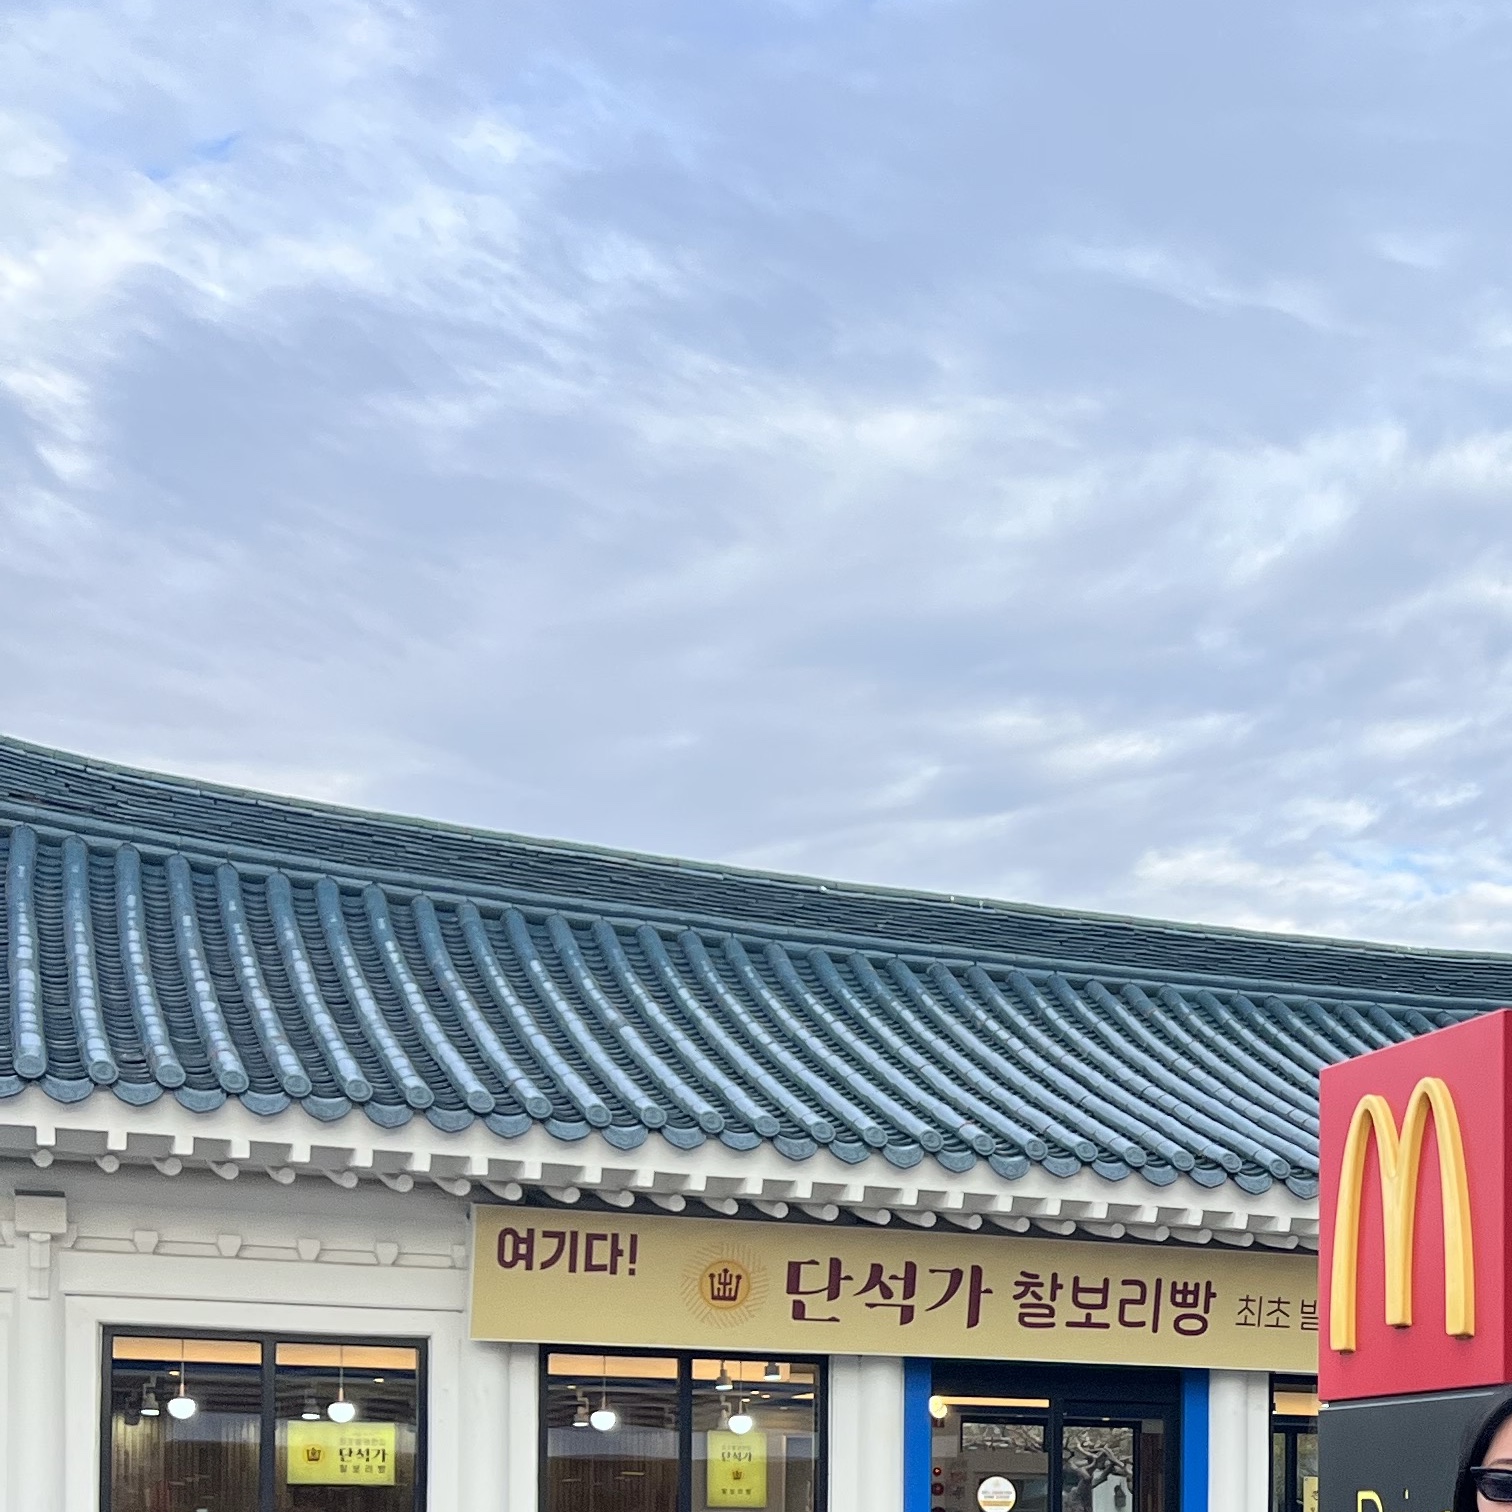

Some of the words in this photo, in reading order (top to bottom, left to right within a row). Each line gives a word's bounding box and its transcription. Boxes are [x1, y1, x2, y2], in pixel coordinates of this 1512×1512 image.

[497, 1227, 638, 1276] 여기다!
[783, 1257, 993, 1329] 단석가
[1012, 1270, 1217, 1336] 찰보리빵
[1235, 1294, 1291, 1329] 최초
